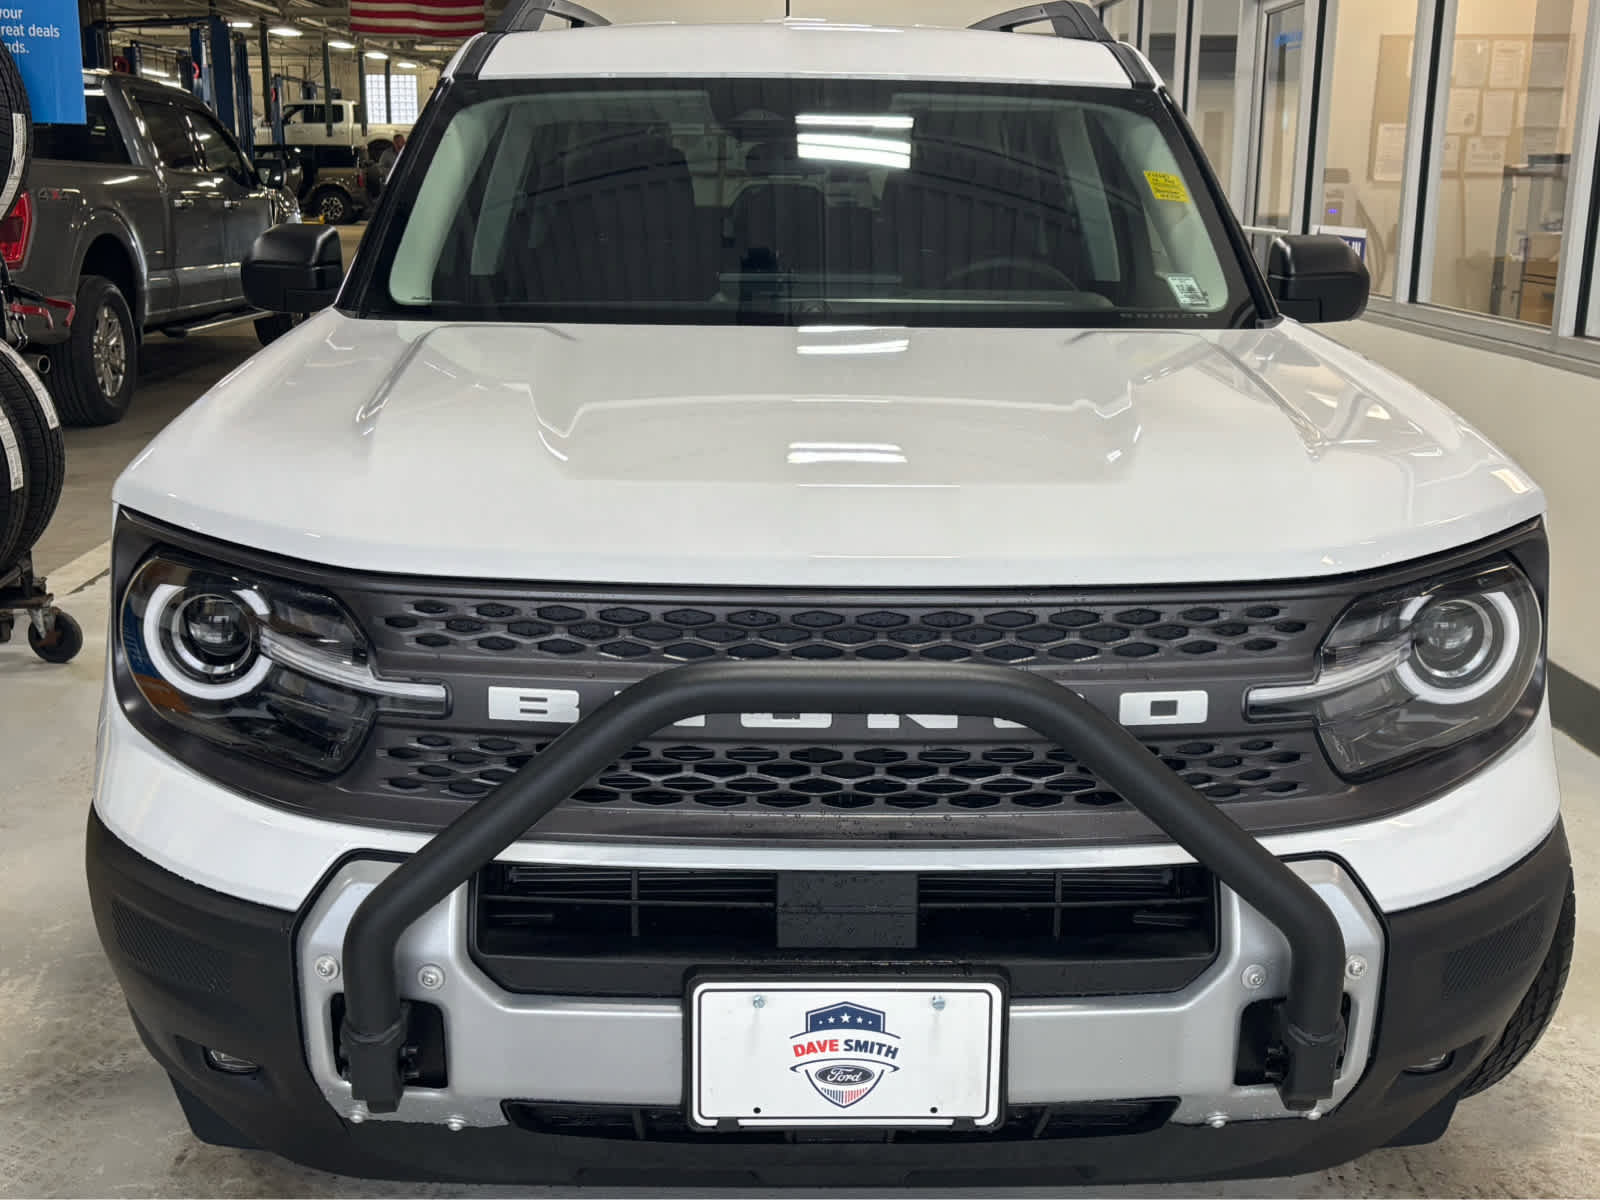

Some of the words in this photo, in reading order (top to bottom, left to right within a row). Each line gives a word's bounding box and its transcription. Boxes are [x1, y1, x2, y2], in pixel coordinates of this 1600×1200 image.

[0, 24, 25, 37] reat
[28, 24, 60, 38] deals
[4, 40, 30, 54] nds.
[793, 1039, 840, 1058] DAVE
[843, 1039, 899, 1060] SMITH
[827, 1067, 862, 1083] Ford
